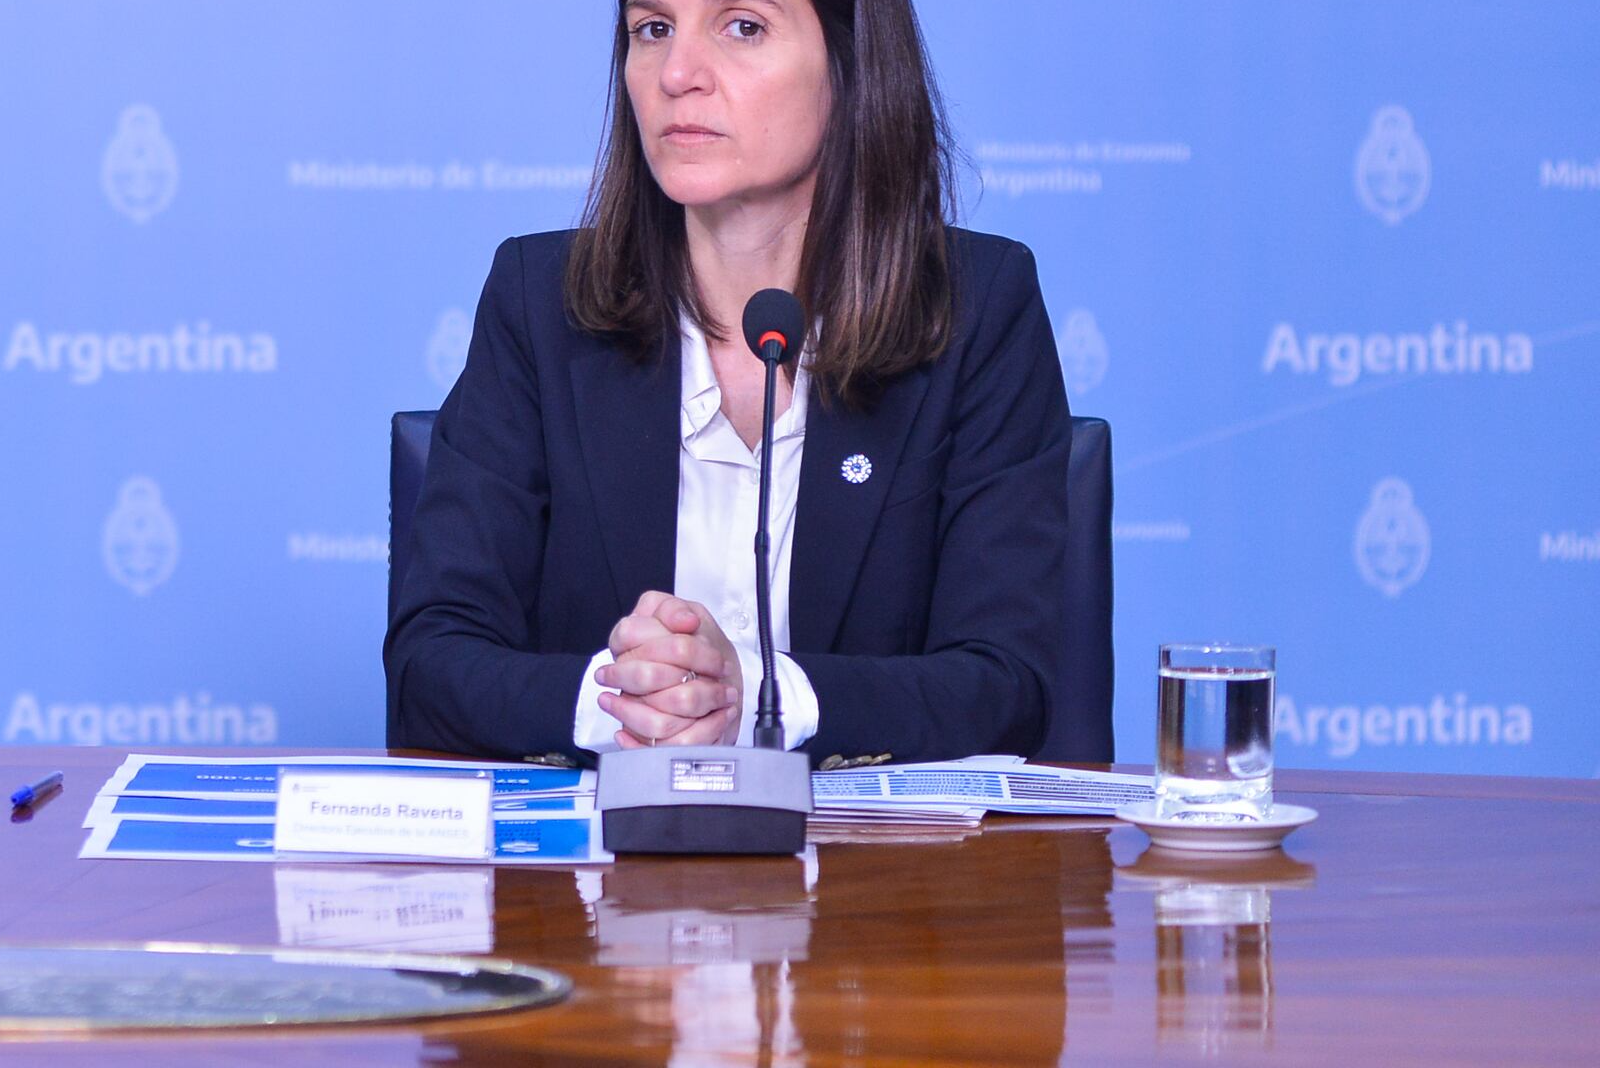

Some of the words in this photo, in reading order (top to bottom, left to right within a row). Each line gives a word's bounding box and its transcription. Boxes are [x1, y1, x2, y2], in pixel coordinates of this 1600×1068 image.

[288, 161, 435, 189] Ministerio
[441, 159, 477, 189] de
[980, 167, 1102, 199] Argentina
[2, 319, 277, 384] Argentina
[1262, 319, 1533, 386] Argentina
[3, 690, 277, 746] Argentina
[309, 800, 391, 818] Fernanda
[397, 803, 464, 821] Raverta
